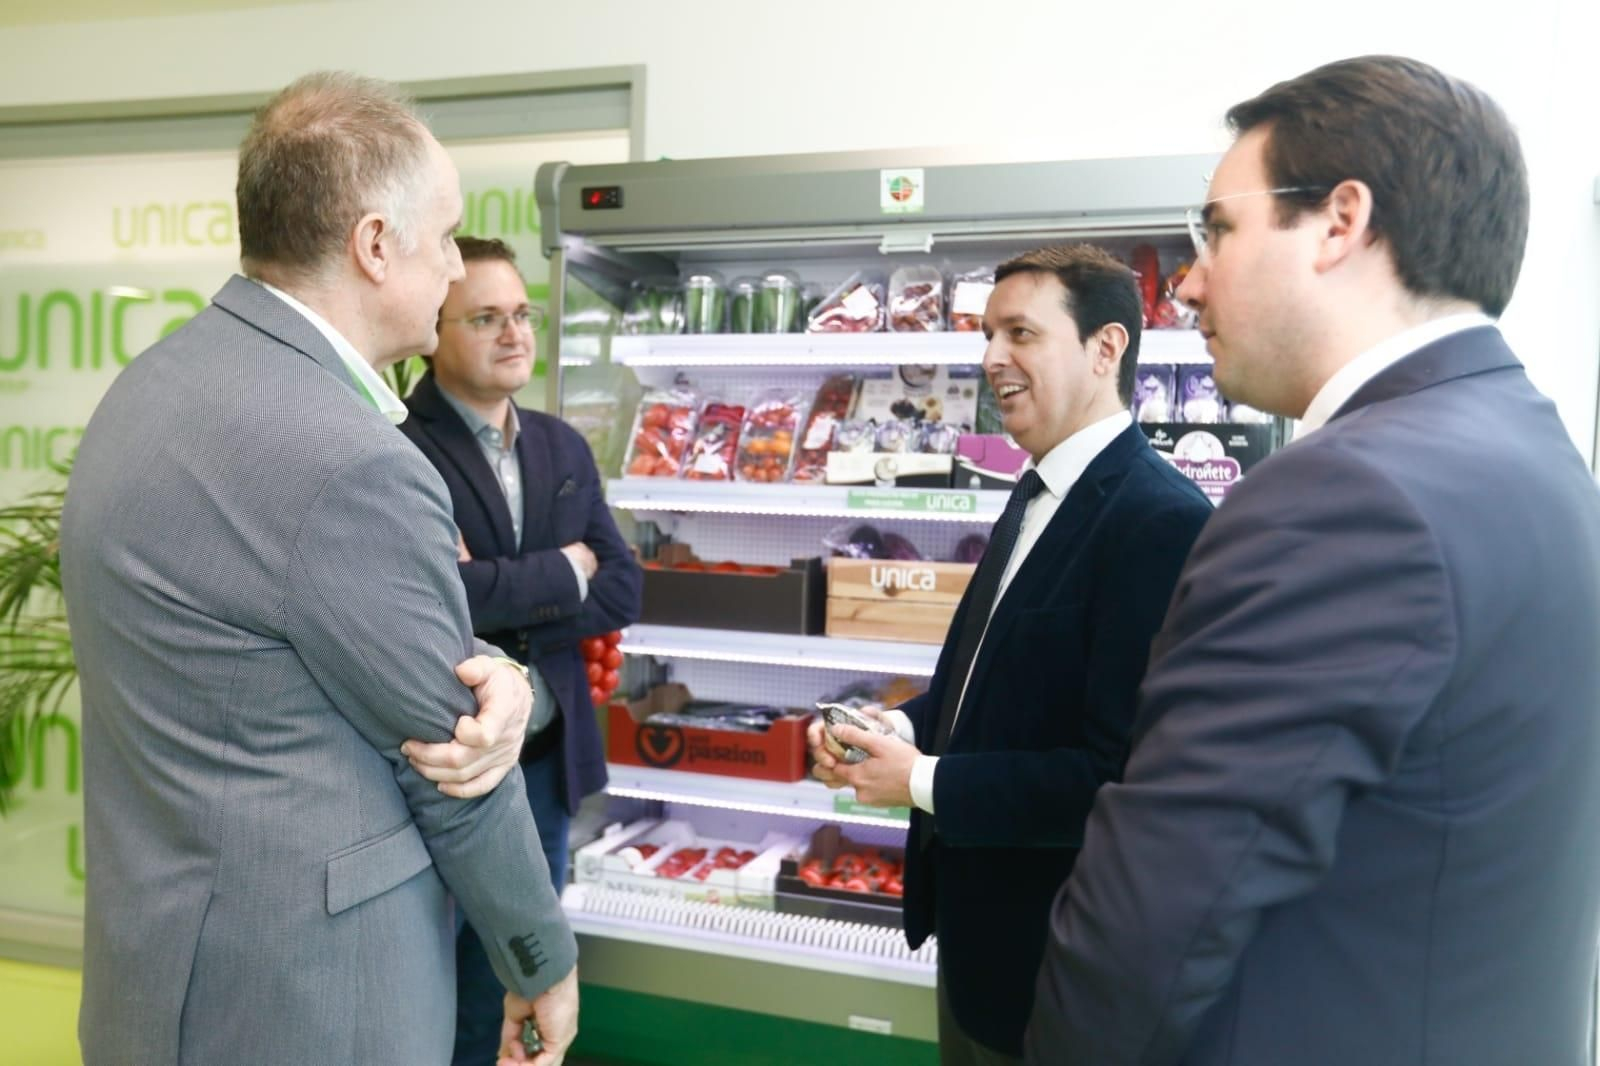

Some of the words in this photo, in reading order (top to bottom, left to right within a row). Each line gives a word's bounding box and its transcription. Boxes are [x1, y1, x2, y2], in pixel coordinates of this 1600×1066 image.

[113, 202, 233, 248] unica
[926, 494, 971, 511] unica
[870, 566, 936, 590] unica
